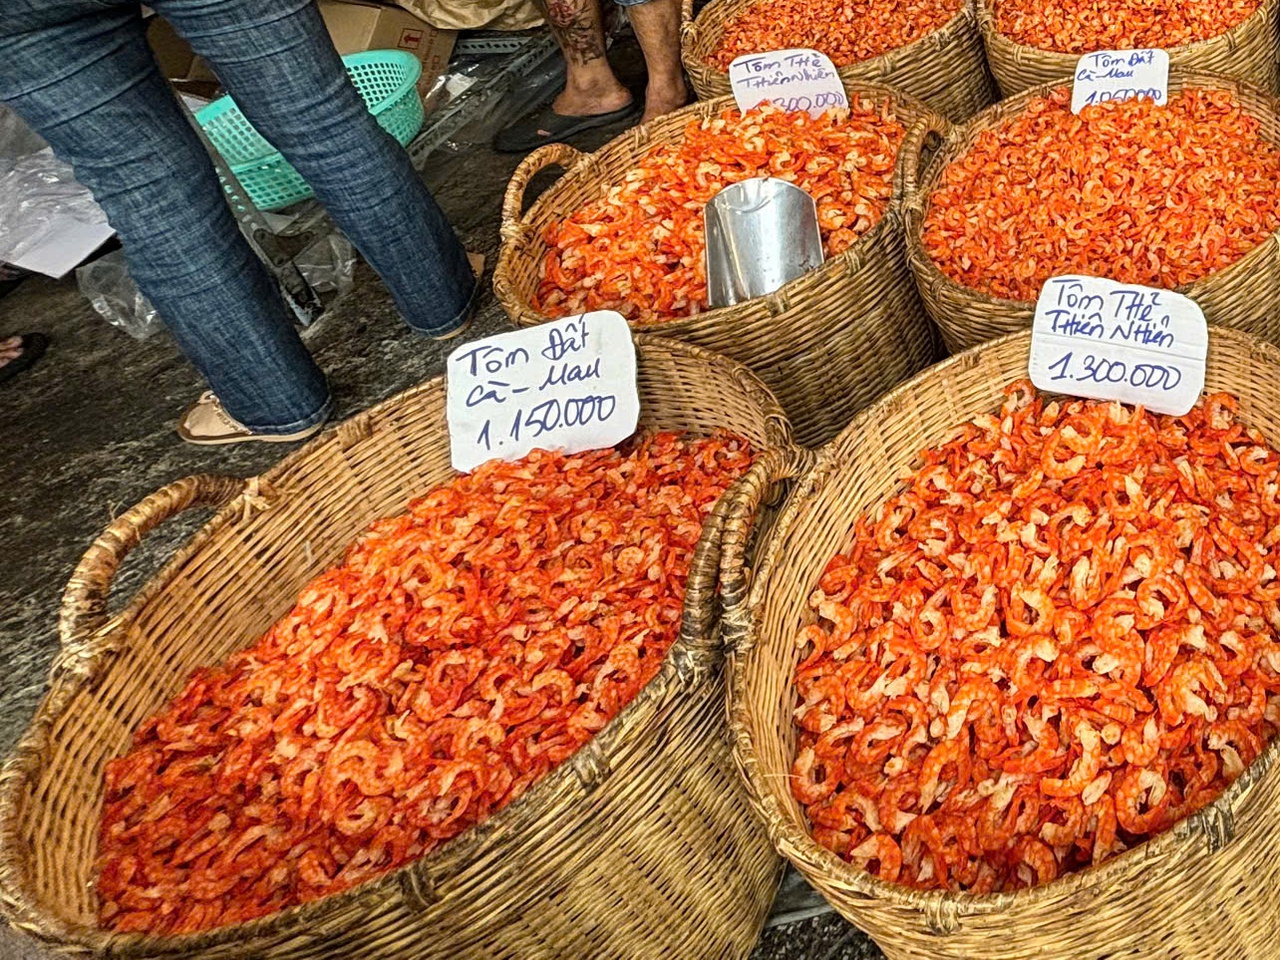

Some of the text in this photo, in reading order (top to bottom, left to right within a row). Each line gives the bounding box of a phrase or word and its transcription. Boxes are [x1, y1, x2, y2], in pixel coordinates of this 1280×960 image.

[733, 56, 781, 74] Tôm
[1088, 50, 1155, 68] Tôm Đất
[1052, 279, 1104, 311] Tôm
[455, 314, 590, 377] Tôm Đất
[1048, 351, 1182, 391] 1.300.000
